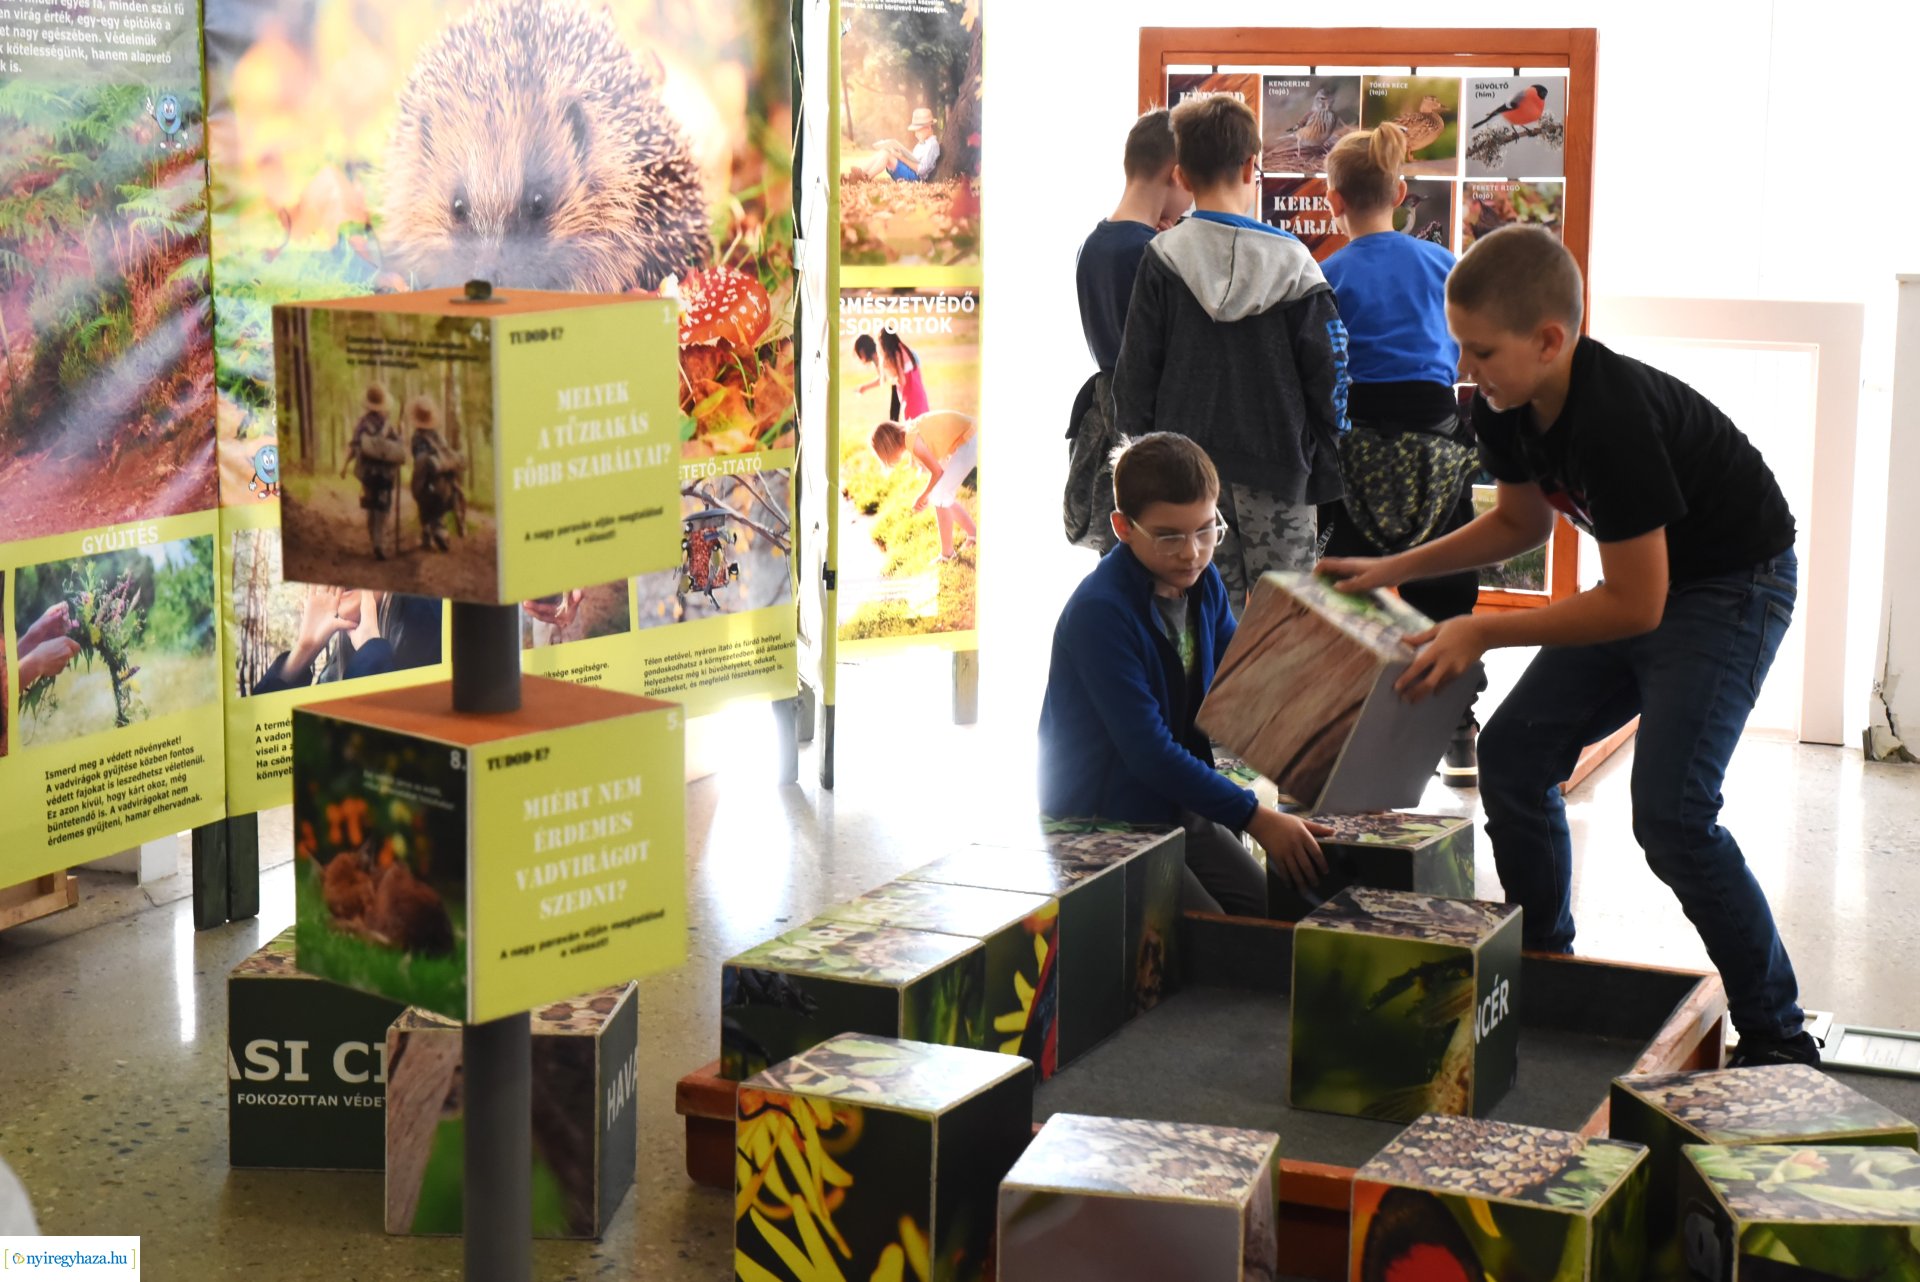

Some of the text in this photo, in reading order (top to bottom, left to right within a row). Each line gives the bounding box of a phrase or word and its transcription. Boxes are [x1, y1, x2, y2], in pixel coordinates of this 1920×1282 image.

[14, 7, 41, 24] virág
[44, 8, 74, 26] érték,
[77, 15, 120, 30] egy-egy
[165, 21, 171, 30] a
[110, 0, 149, 12] minden
[152, 1, 172, 14] szál
[14, 27, 38, 41] nagy
[42, 26, 102, 43] egészében.
[104, 31, 157, 46] Védelmük
[6, 42, 88, 60] kötelességünk,
[91, 47, 128, 60] hanem
[131, 50, 172, 65] alapvető
[10, 60, 22, 72] is.
[1268, 80, 1310, 88] KENDERIKE
[1268, 88, 1290, 96] (tojó)
[558, 380, 630, 412] MELYEK
[538, 428, 550, 450] A
[512, 456, 563, 491] FŐBB
[679, 452, 762, 480] TETŐ-ITATÓ
[82, 521, 159, 555] GYŰJTÉS
[644, 657, 662, 666] Télen
[694, 647, 716, 657] nyáron
[718, 643, 732, 652] itató
[760, 632, 782, 644] hellyel
[570, 662, 610, 674] segítségre.
[644, 661, 697, 678] gondoskodhatsz
[704, 650, 754, 665] környezetedben
[690, 680, 698, 688] és
[732, 664, 776, 680] fészekanyagot
[644, 674, 684, 688] Helyezhetsz
[686, 670, 700, 679] még
[700, 668, 707, 676] ki
[256, 723, 262, 732] A
[256, 732, 292, 744] A vadon
[46, 736, 182, 781] Ismerd meg a védett növényeket!
[256, 744, 279, 756] viseli
[282, 744, 287, 752] a
[450, 750, 467, 772] 8.
[486, 747, 550, 771] TUDOD-E?
[46, 746, 194, 794] A vadvirágok gyűjtése közben fontos
[256, 760, 268, 768] Ha
[46, 754, 205, 806] védett fajokat is leszedhetsz véletlenül.
[47, 772, 187, 820] Ez azon kívül, hogy kárt okoz, még
[523, 776, 642, 820] MIÉRT NEM
[48, 785, 188, 833] büntetendő is. A vadvirágokat nem
[48, 794, 203, 846] érdemes gyűjteni, hamar elhervadnak.
[534, 811, 633, 854] ÉRDEMES
[514, 841, 650, 891] VADVIRÁGOT
[539, 879, 628, 920] SZEDNI?
[237, 1092, 338, 1107] FOKOZOTTAN
